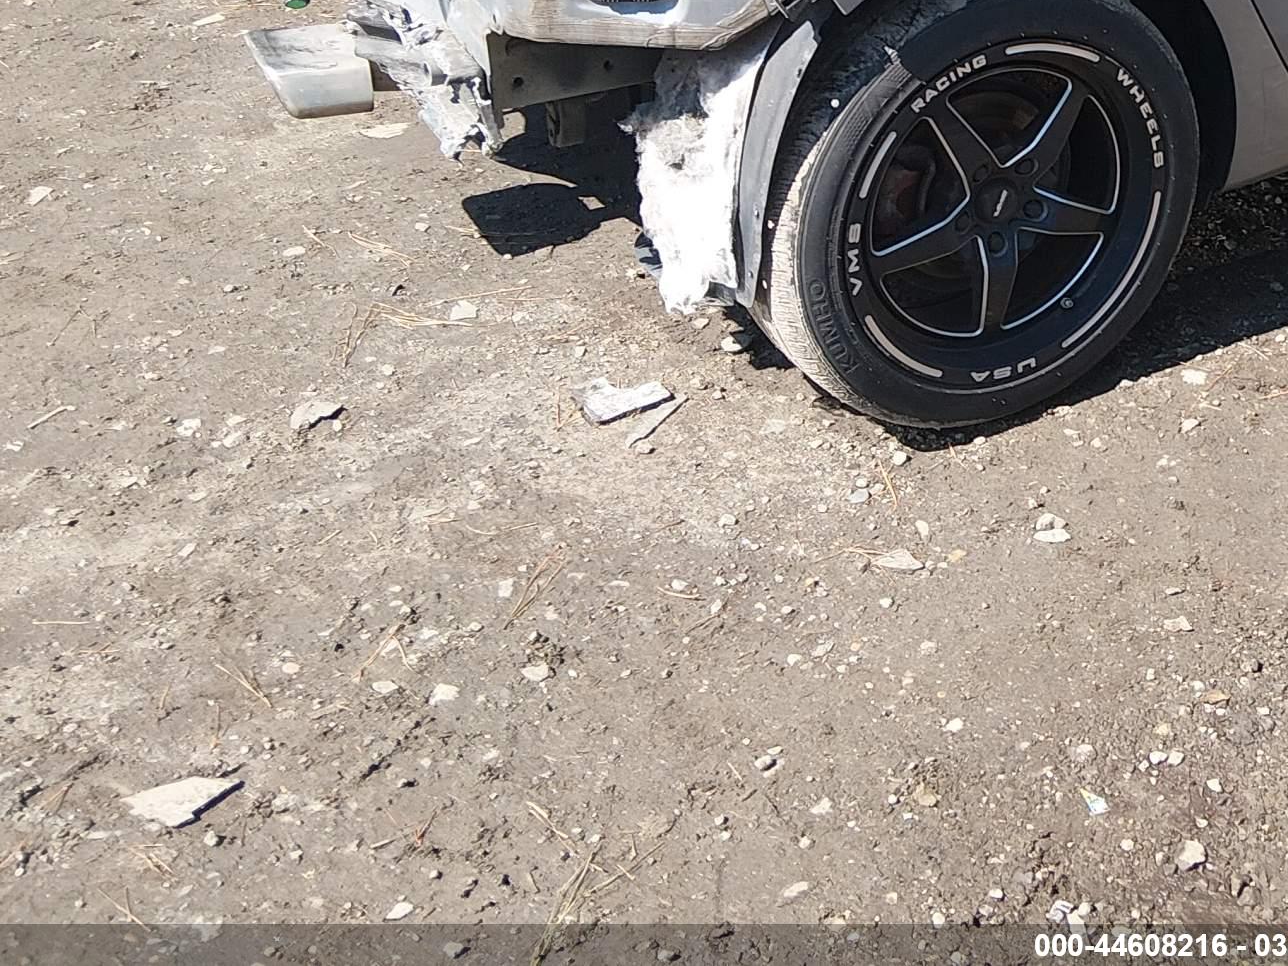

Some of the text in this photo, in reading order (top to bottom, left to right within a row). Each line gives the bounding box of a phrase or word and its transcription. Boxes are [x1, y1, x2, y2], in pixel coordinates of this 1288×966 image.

[847, 54, 1164, 382] VMS RACING WHEELS USA
[809, 281, 861, 375] KUMHO
